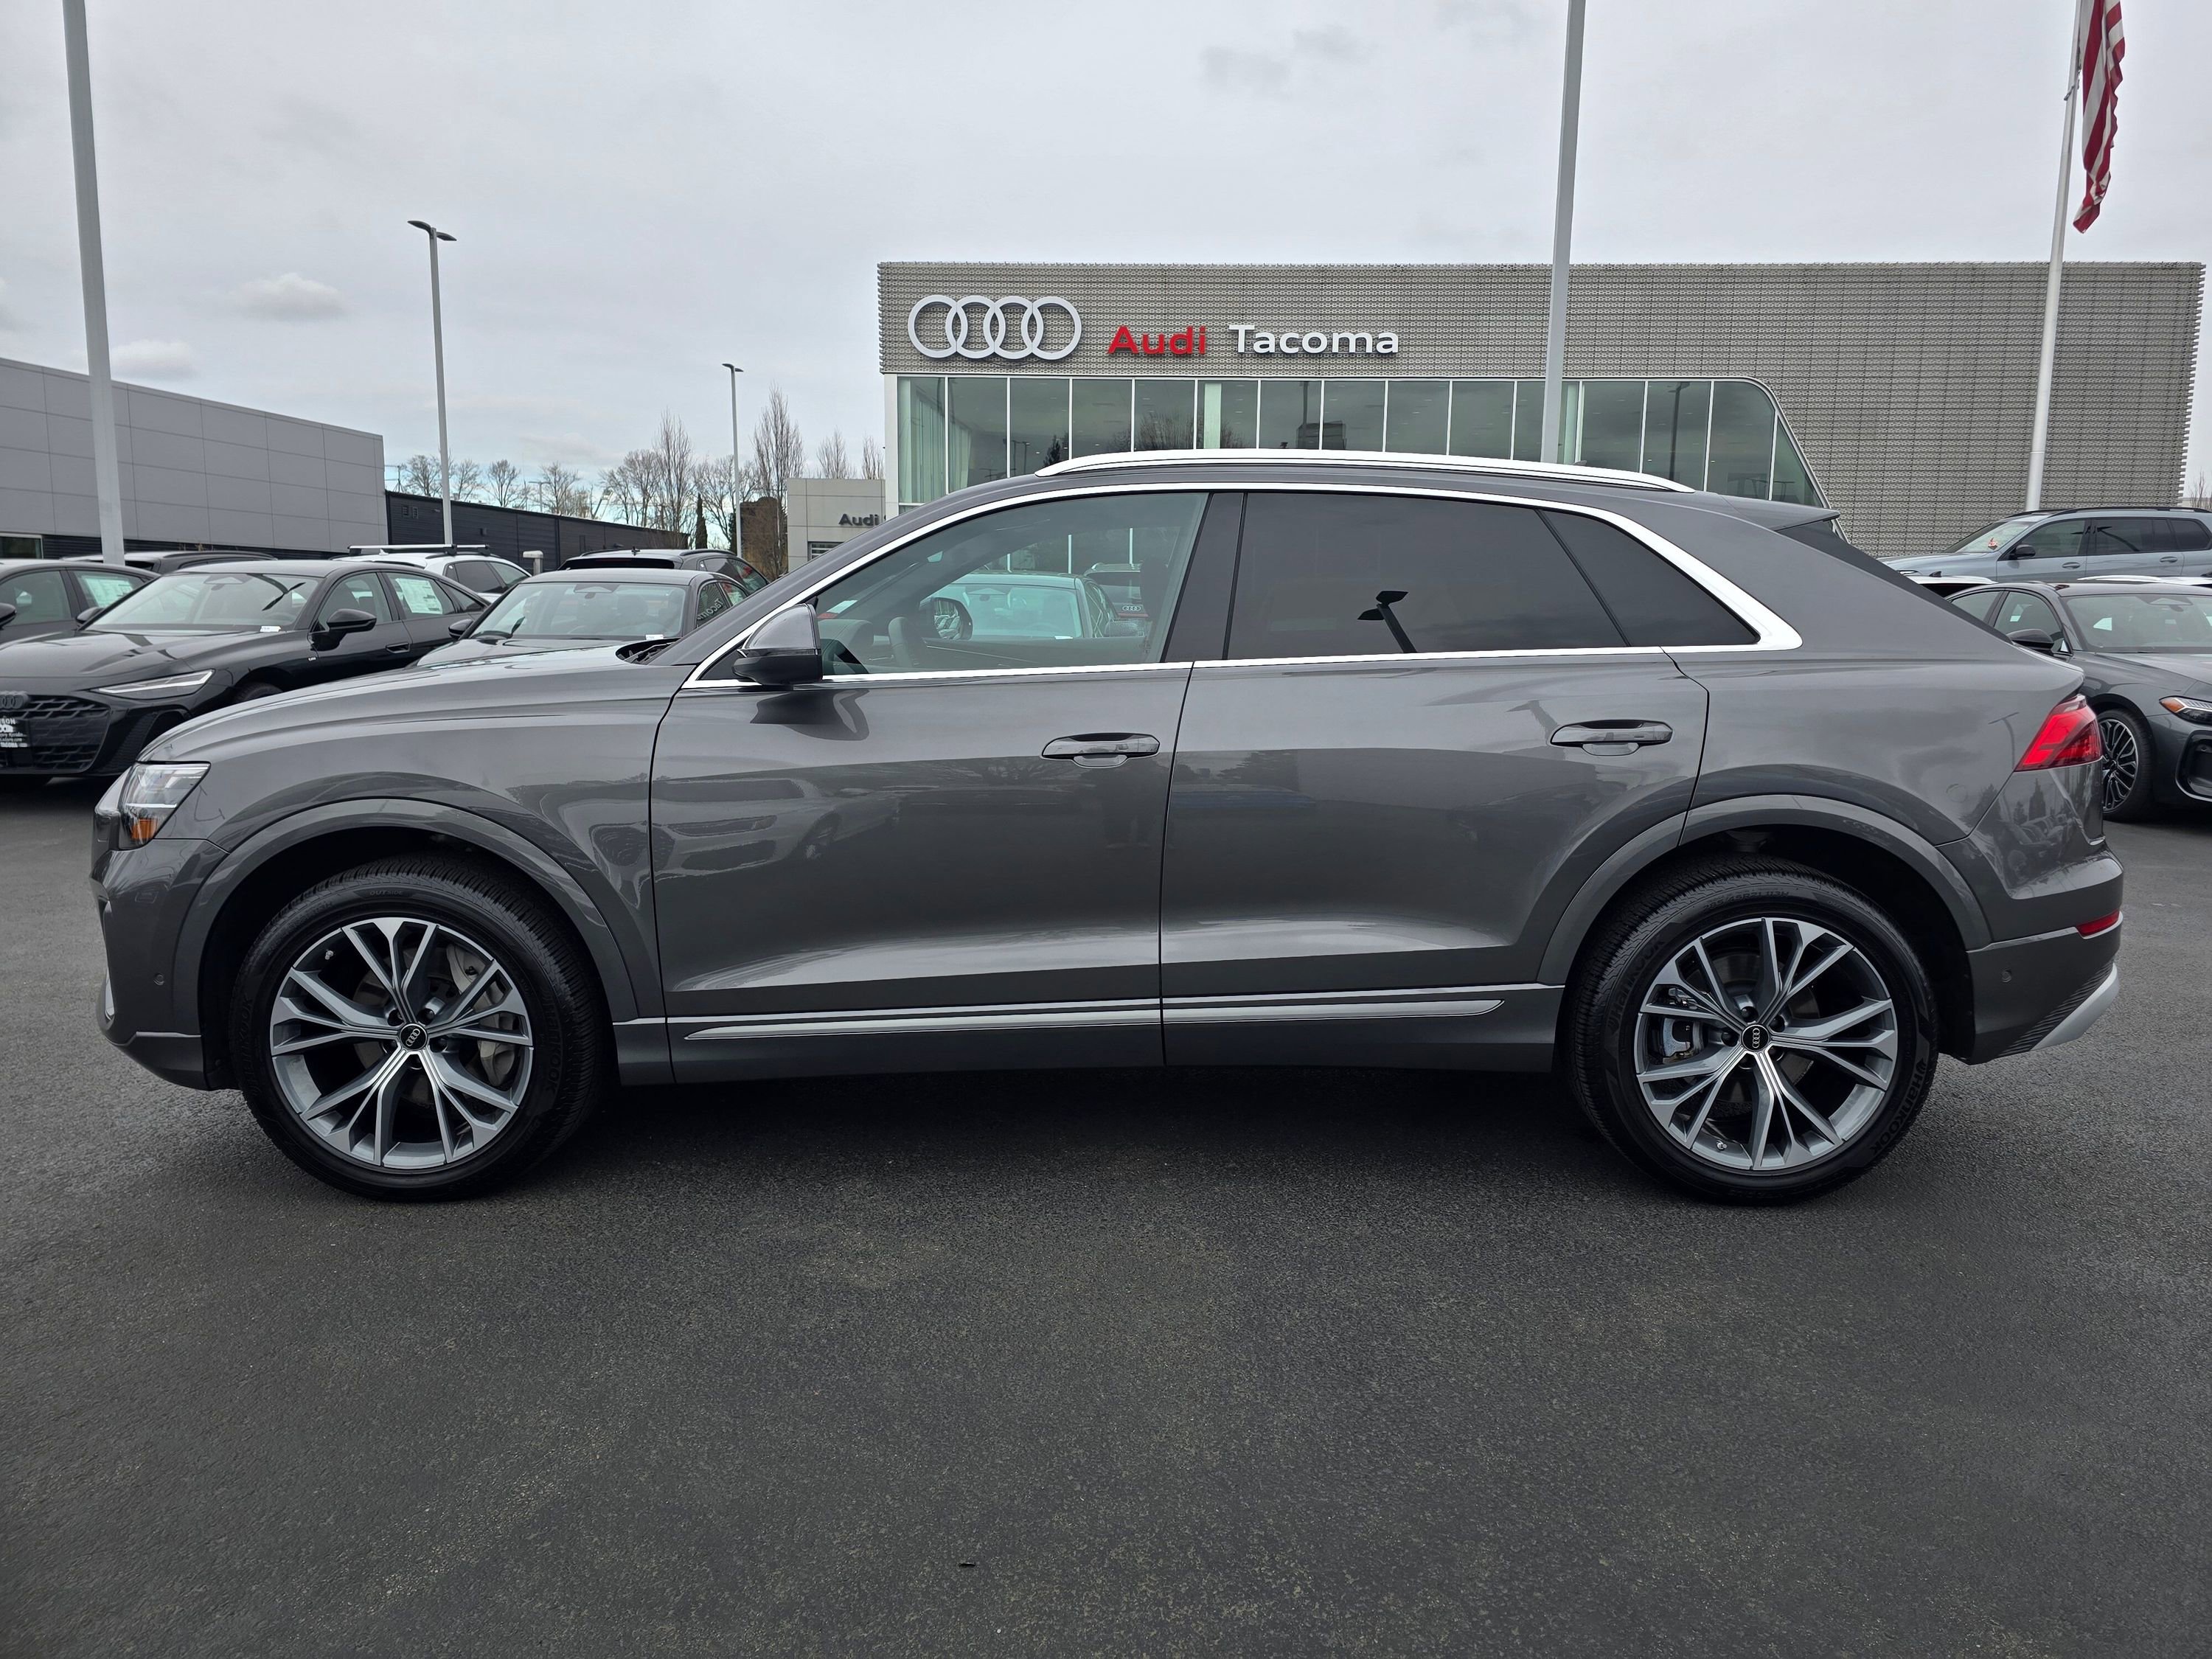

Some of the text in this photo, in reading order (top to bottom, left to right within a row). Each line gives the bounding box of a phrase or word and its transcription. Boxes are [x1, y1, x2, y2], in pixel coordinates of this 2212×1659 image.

[1107, 324, 1399, 354] Audi Tacoma
[838, 513, 880, 526] Audi
